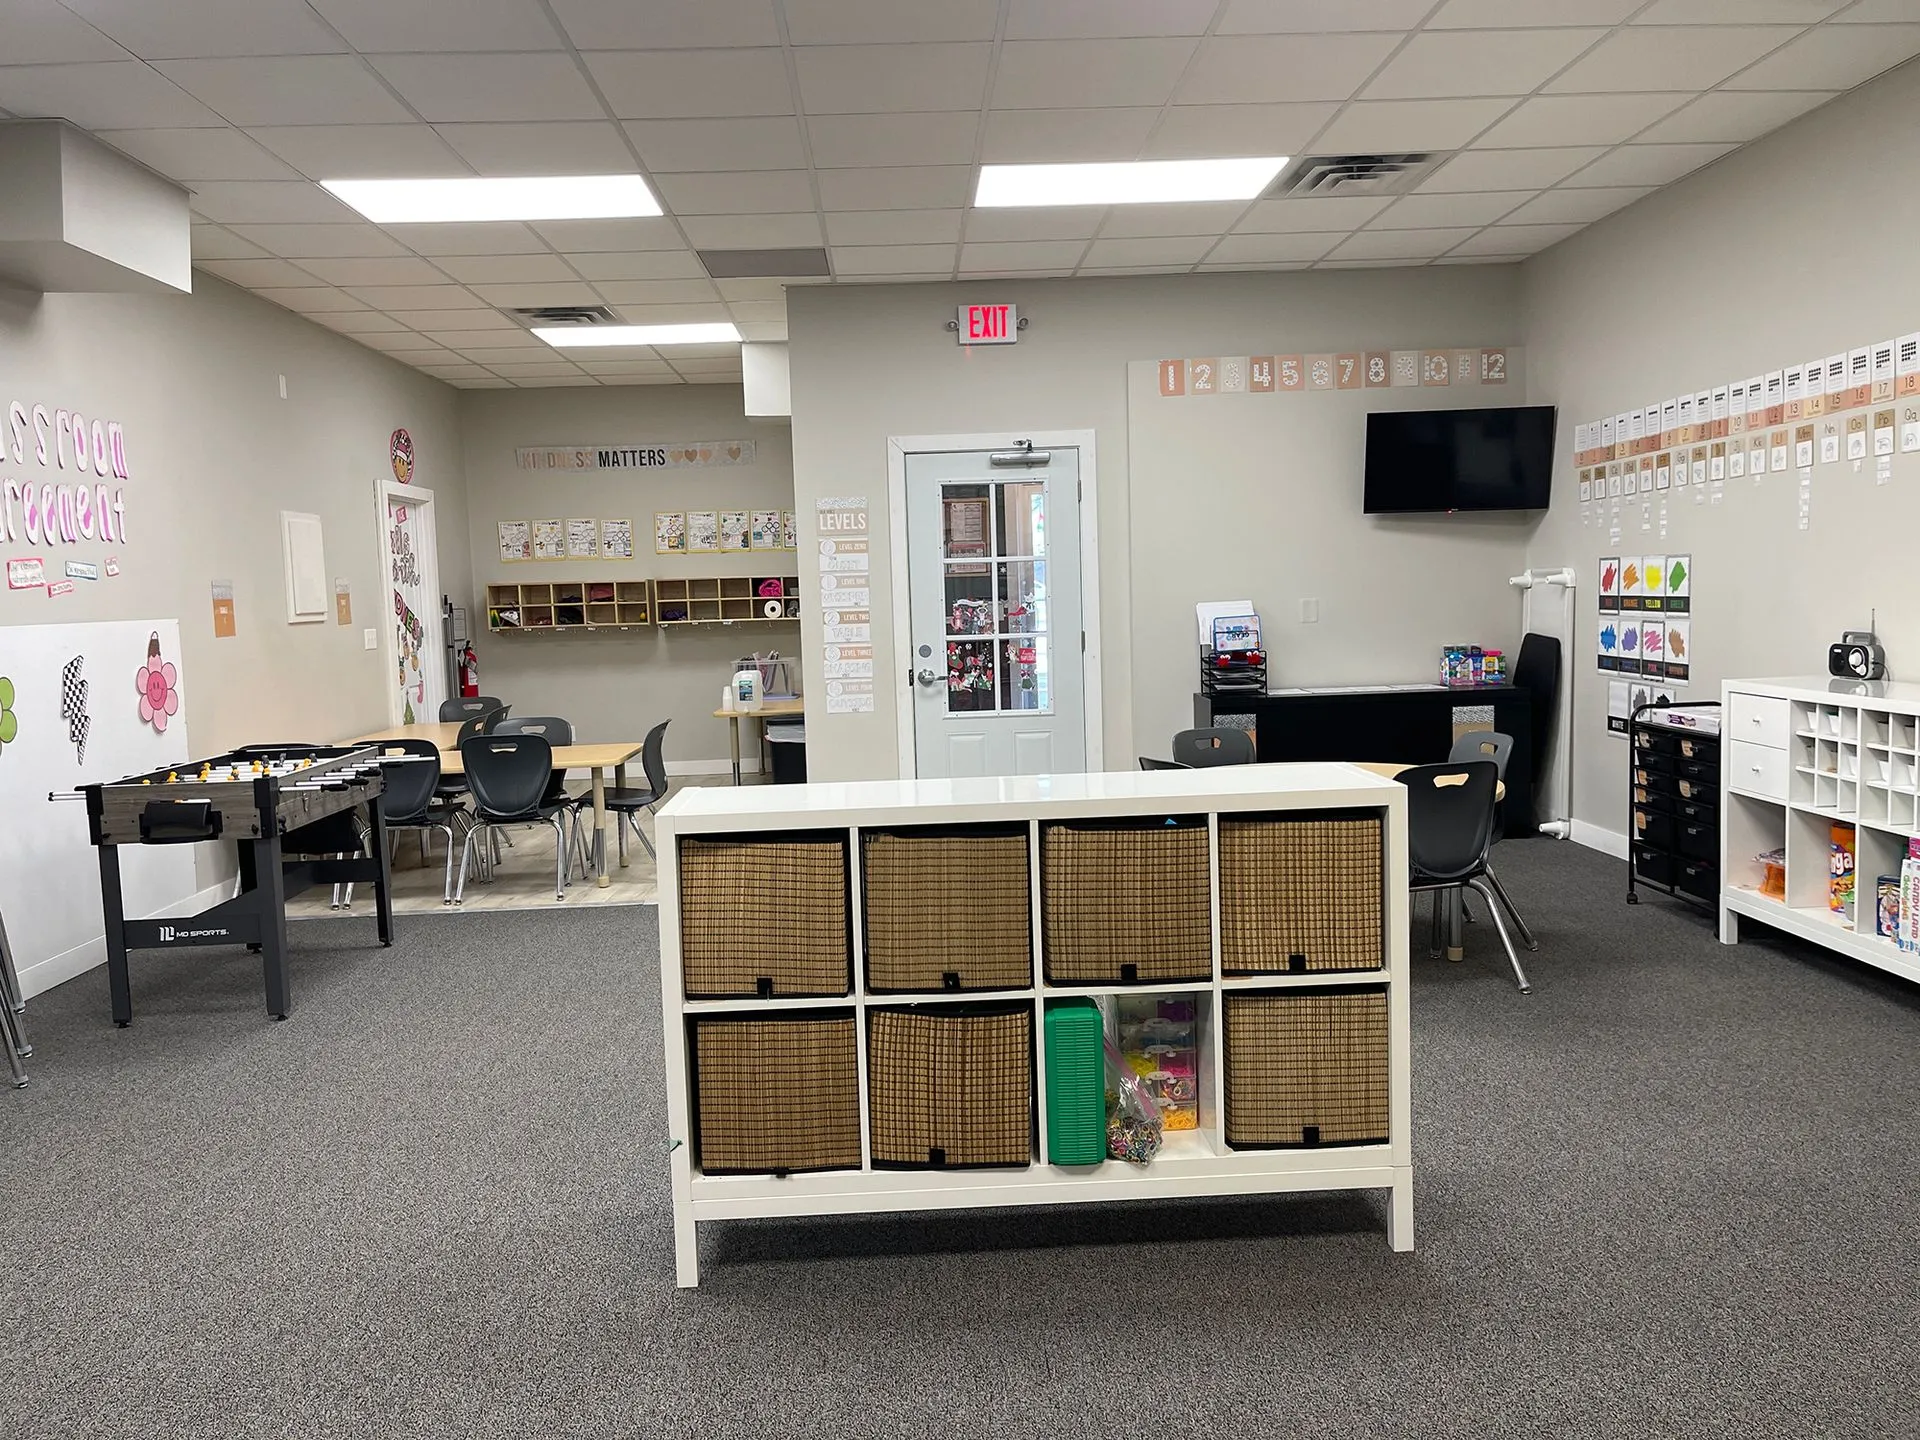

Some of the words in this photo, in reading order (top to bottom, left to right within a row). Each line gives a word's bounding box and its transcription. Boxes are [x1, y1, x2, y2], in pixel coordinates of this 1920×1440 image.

[968, 306, 1008, 338] EXIT
[1168, 365, 1175, 391] 1
[1195, 364, 1211, 389] 2
[1223, 363, 1240, 387] 3
[1253, 361, 1271, 387] 4
[1283, 360, 1299, 386] 5
[1312, 360, 1329, 385] 6
[1340, 359, 1354, 384] 7
[1369, 357, 1385, 382] 8
[1397, 356, 1413, 379] 9
[1424, 355, 1448, 380] 10
[1481, 353, 1504, 379] 12
[1683, 428, 1688, 437] 7
[1734, 417, 1742, 427] 10
[1752, 412, 1758, 422] 11
[1790, 403, 1798, 414] 13
[1811, 400, 1819, 410] 14
[1832, 394, 1841, 405] 15
[1855, 388, 1864, 400] 16
[1879, 383, 1888, 395] 17
[1905, 376, 1915, 388] 18
[0, 400, 129, 479] ssroom
[598, 449, 665, 467] MATTERS
[0, 478, 127, 546] reement
[820, 513, 866, 530] LEVELS
[842, 649, 856, 657] LEVEL
[1912, 877, 1920, 911] CANDY
[1911, 914, 1919, 939] LAND
